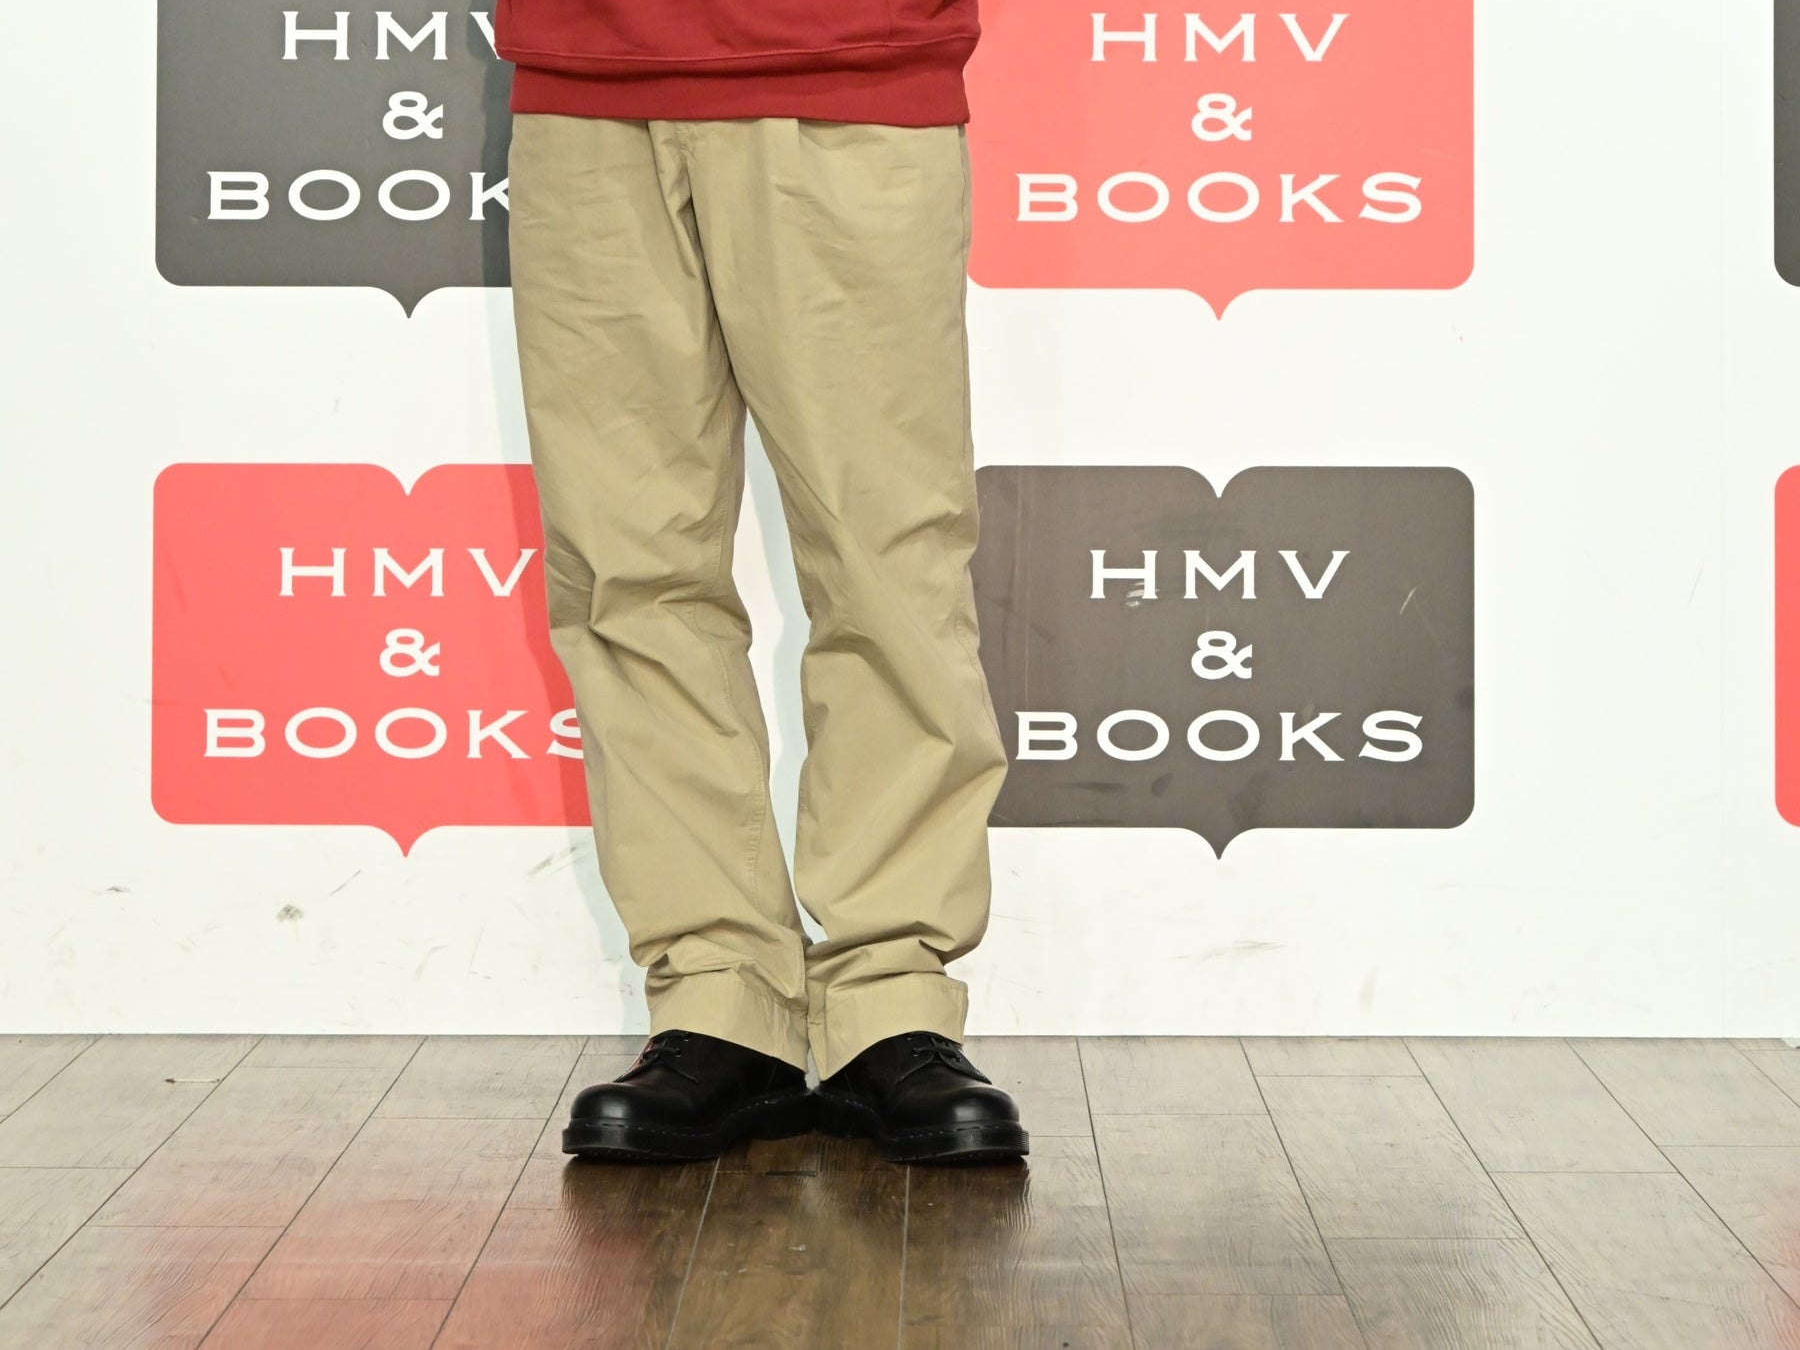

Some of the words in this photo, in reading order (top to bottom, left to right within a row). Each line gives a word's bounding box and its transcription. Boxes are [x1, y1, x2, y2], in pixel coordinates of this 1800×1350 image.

[1091, 13, 1349, 62] HMV
[382, 90, 444, 140] &
[1191, 93, 1253, 142] &
[206, 169, 510, 221] BOOK
[1016, 171, 1423, 223] BOOKS
[279, 547, 538, 597] HMV
[1090, 549, 1351, 600] HMV
[379, 628, 441, 678] &
[1191, 630, 1253, 680] &
[1014, 709, 1423, 762] BOOKS
